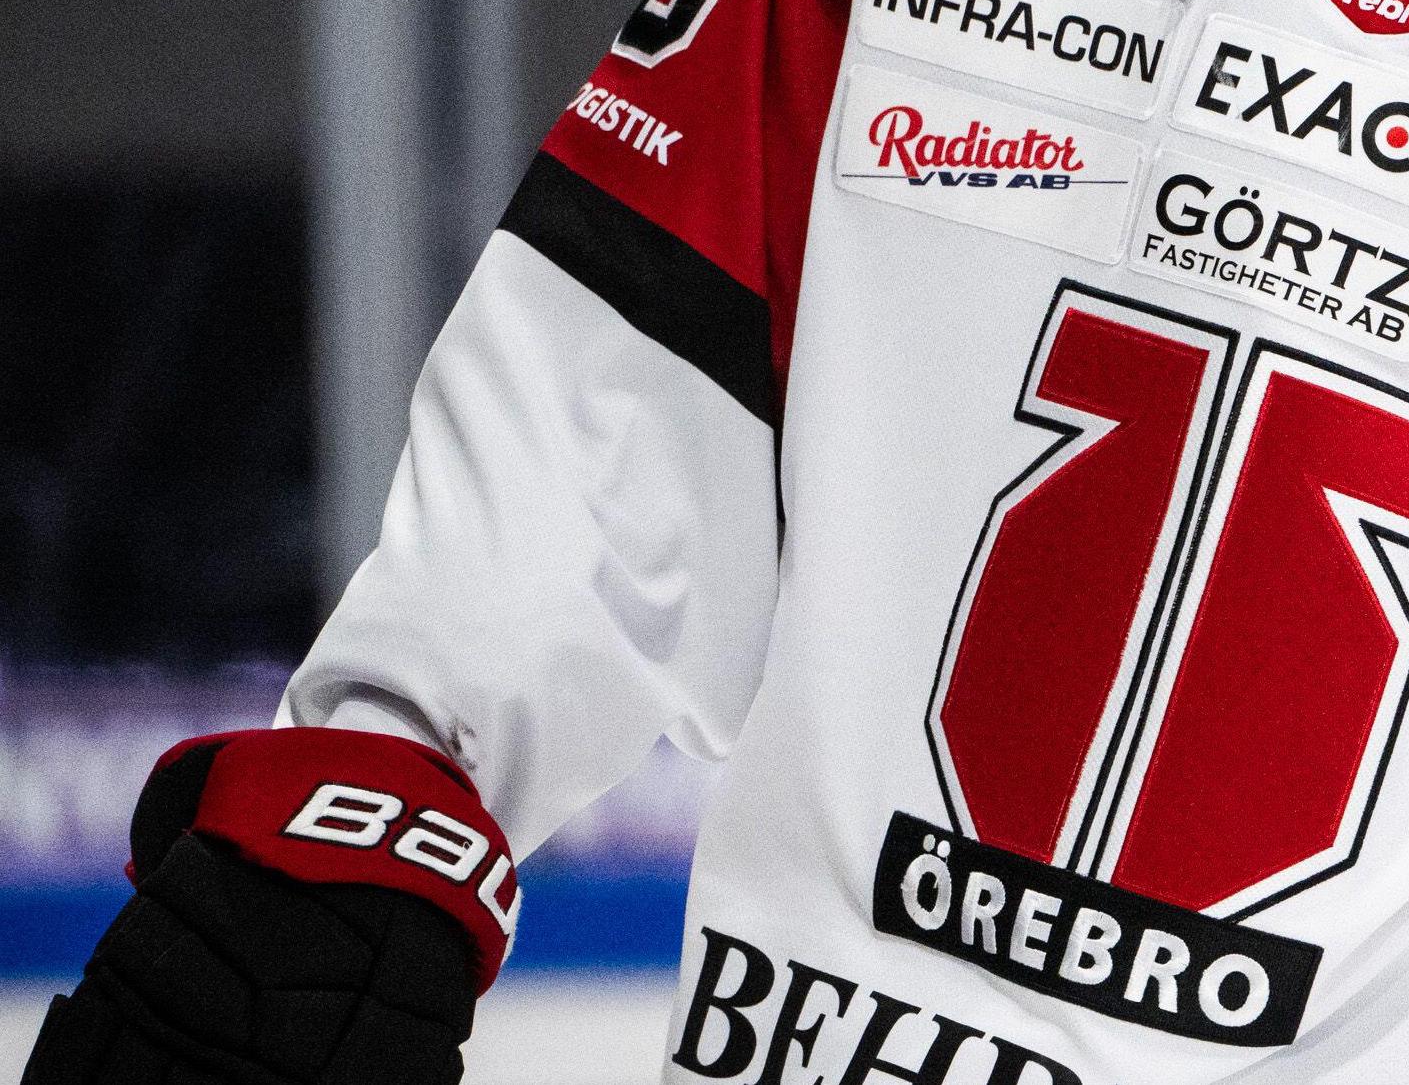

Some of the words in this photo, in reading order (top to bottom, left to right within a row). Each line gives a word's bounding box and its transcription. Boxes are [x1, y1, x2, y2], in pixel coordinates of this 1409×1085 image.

[869, 105, 1084, 178] Radiator
[907, 171, 998, 188] VVS
[1006, 173, 1071, 190] AB
[1141, 233, 1343, 322] FASTIGHETER
[1345, 299, 1406, 343] AB
[901, 834, 1271, 1027] ÖREBRO
